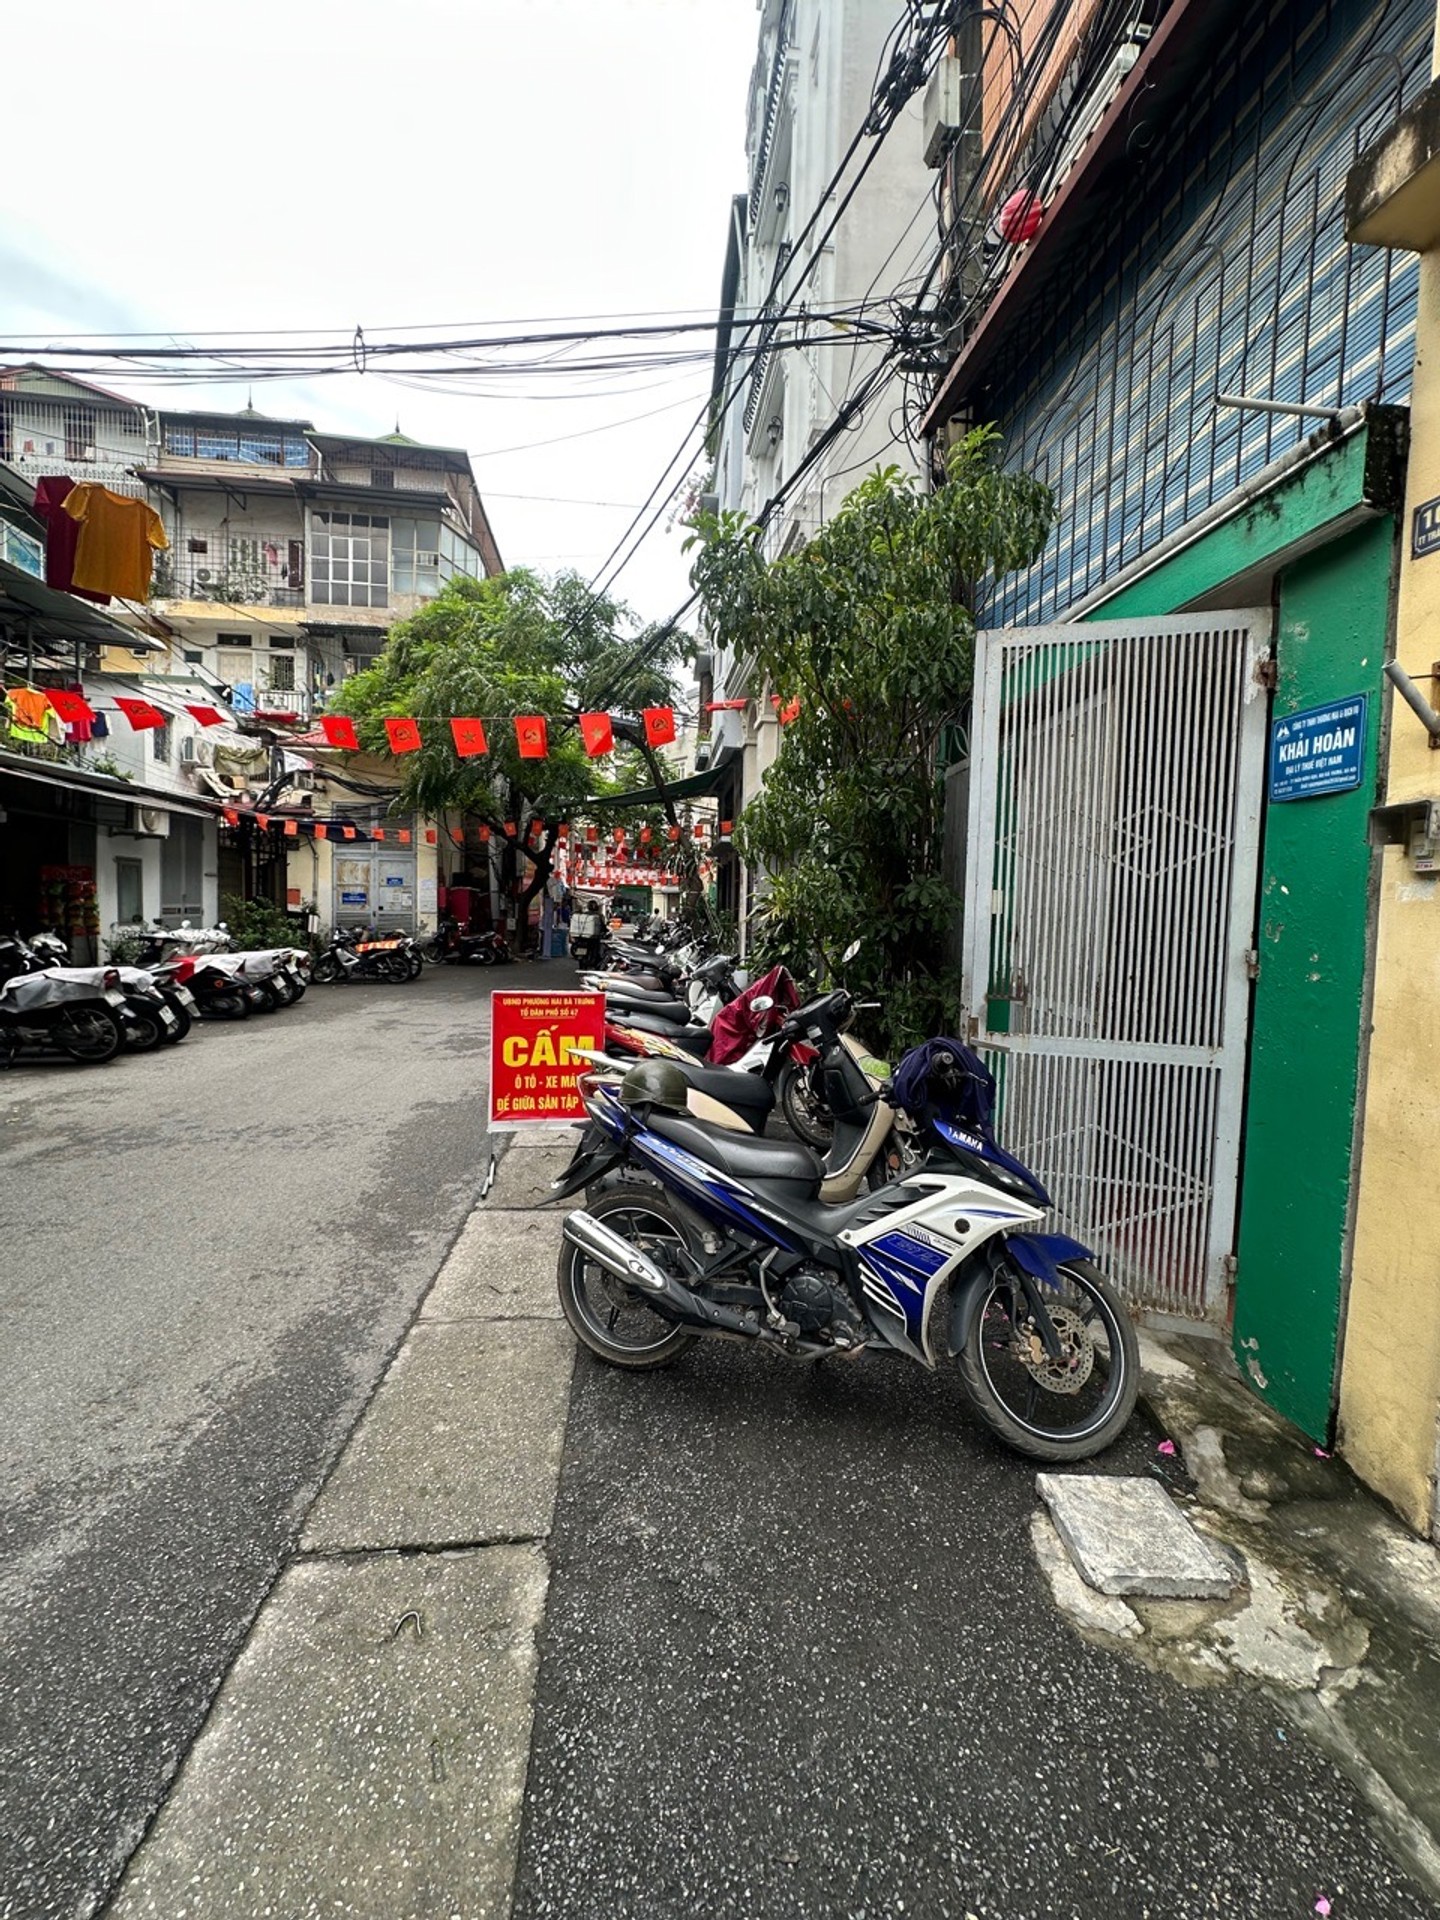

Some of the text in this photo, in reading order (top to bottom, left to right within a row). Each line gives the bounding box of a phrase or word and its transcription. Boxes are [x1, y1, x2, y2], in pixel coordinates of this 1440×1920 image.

[1279, 727, 1355, 763] KHẢI HOÀN
[1315, 757, 1327, 769] VIỆT
[1328, 755, 1342, 766] NAM
[530, 1007, 544, 1016] DÂN
[570, 1008, 579, 1016] 47
[503, 1025, 594, 1067] CẤM
[515, 1074, 522, 1089] Ô
[524, 1073, 537, 1089] TÔ
[545, 1075, 558, 1089] XE
[513, 1095, 535, 1110] GIỮA
[538, 1094, 557, 1109] SÂN
[561, 1094, 579, 1111] TẬP
[948, 1126, 983, 1151] YAMAHA
